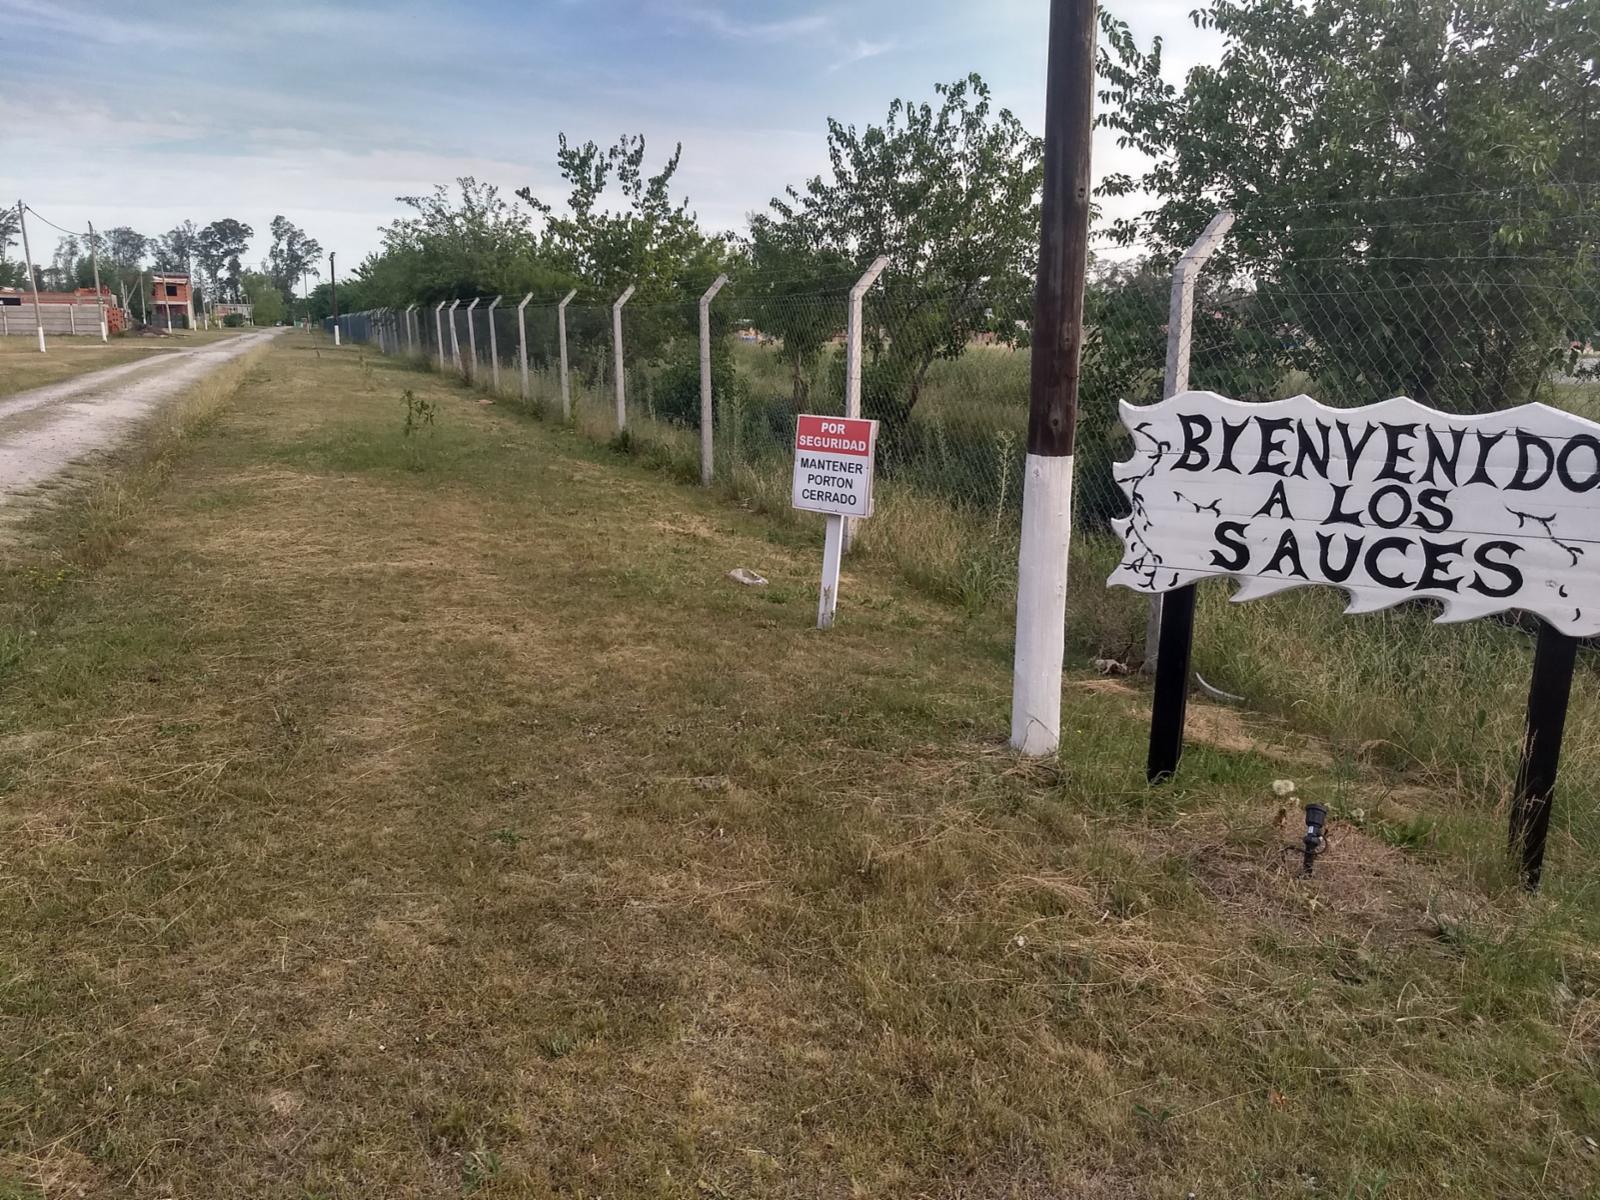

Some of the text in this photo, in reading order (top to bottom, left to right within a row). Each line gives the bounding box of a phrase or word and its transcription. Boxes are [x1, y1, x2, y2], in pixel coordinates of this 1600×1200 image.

[821, 422, 846, 435] POR
[799, 435, 867, 452] SEGURIDAD
[1170, 413, 1600, 493] BIENVENIDO
[800, 457, 864, 475] MANTENER
[807, 473, 854, 489] PORTON
[801, 488, 858, 506] CERRADO
[1251, 479, 1453, 533] A LOS
[1209, 521, 1526, 598] SAUCES
